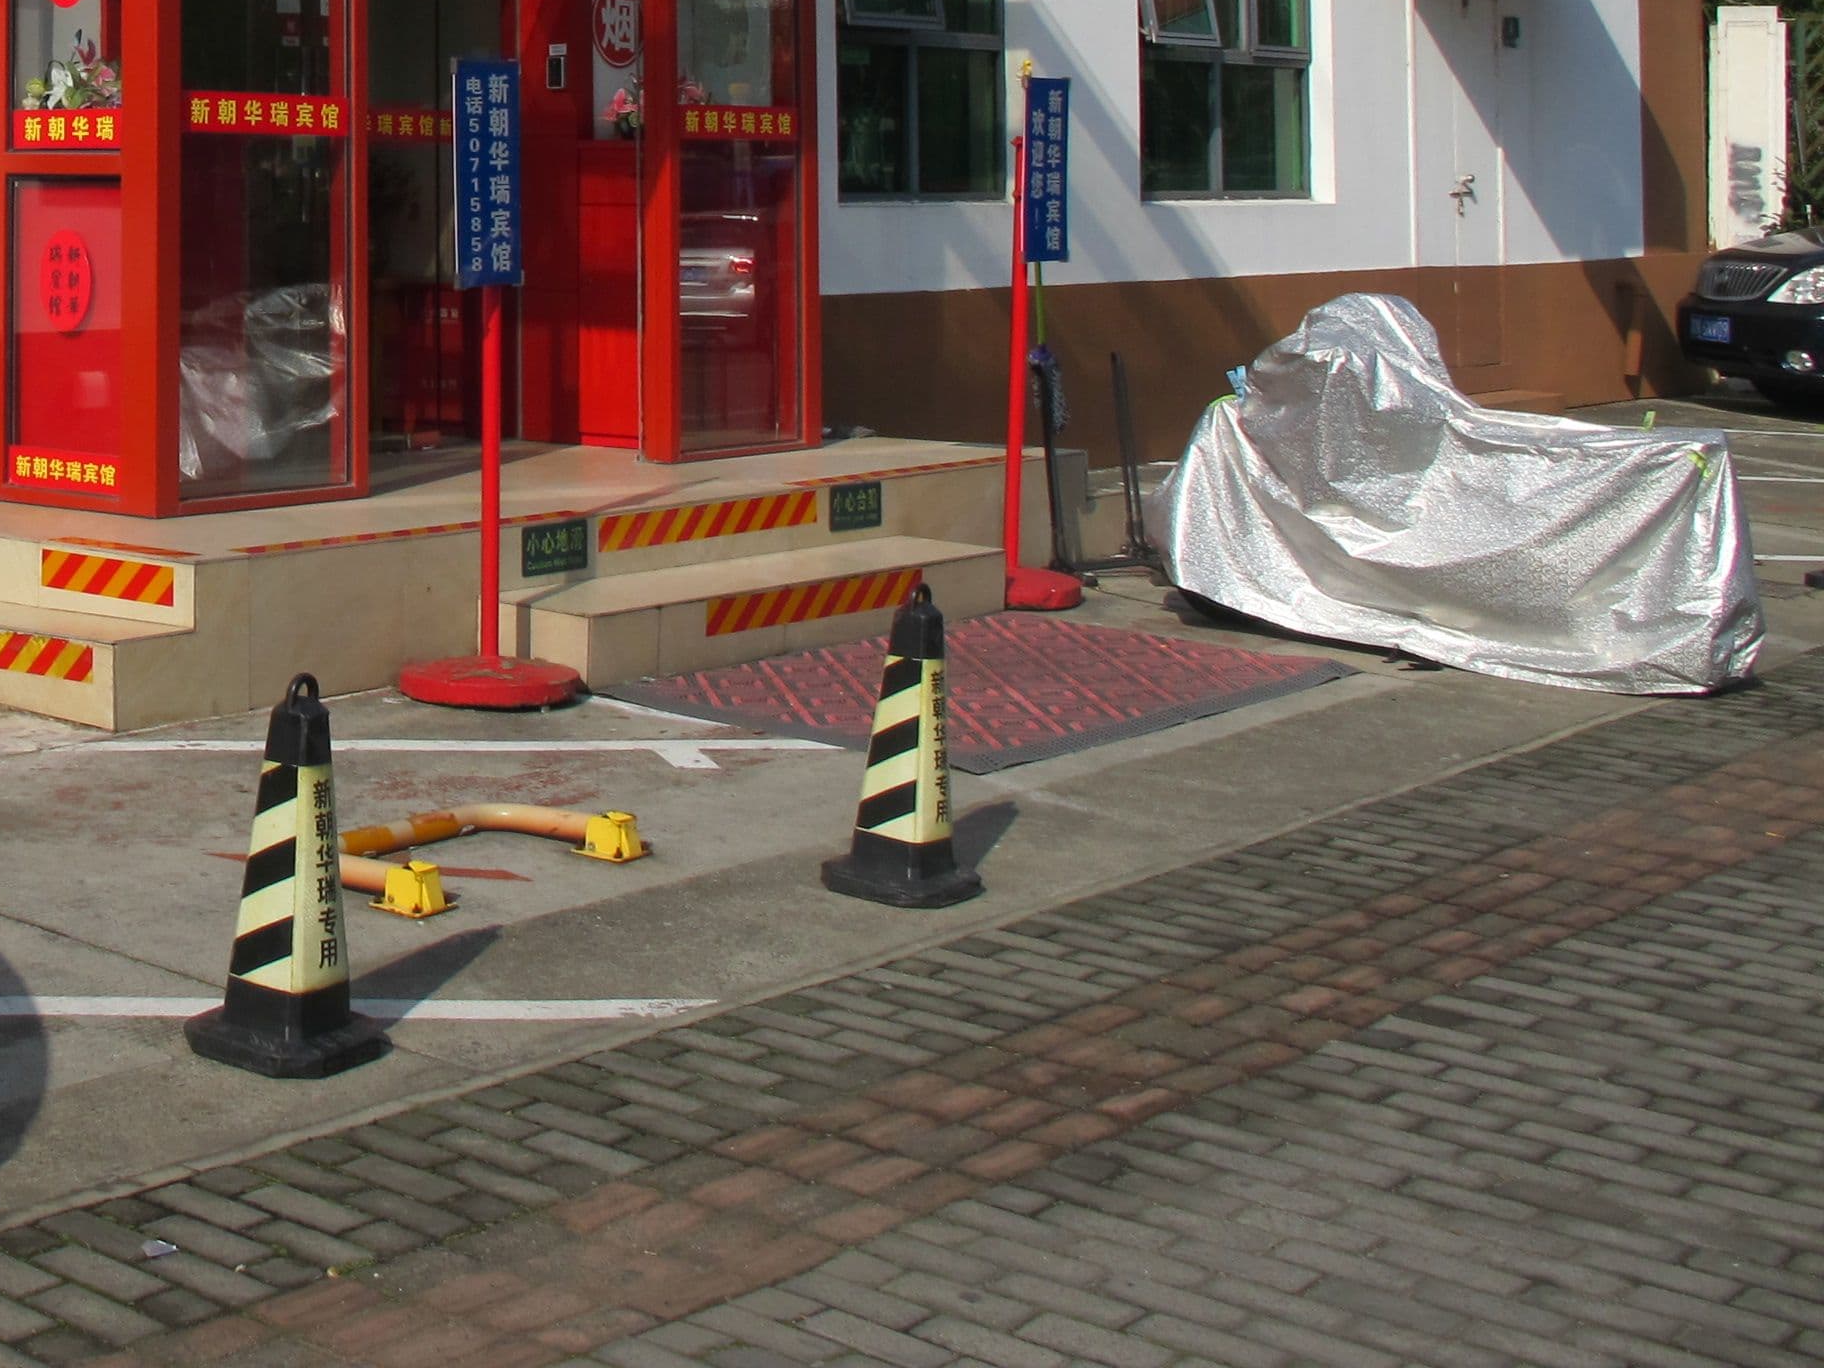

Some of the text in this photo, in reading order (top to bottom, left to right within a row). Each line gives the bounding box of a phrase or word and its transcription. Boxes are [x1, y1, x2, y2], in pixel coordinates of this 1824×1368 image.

[24, 115, 114, 142] 新朝华瑞
[190, 97, 340, 130] 新朝华瑞宾馆
[685, 109, 792, 135] 新朝华瑞宾馆
[465, 76, 483, 272] 电话50715858
[487, 74, 512, 273] 新朝华瑞宾馆
[1046, 89, 1063, 251] 新朝华瑞宾馆
[16, 455, 116, 487] 新朝华瑞宾馆
[313, 779, 339, 969] 新朝华瑞专用
